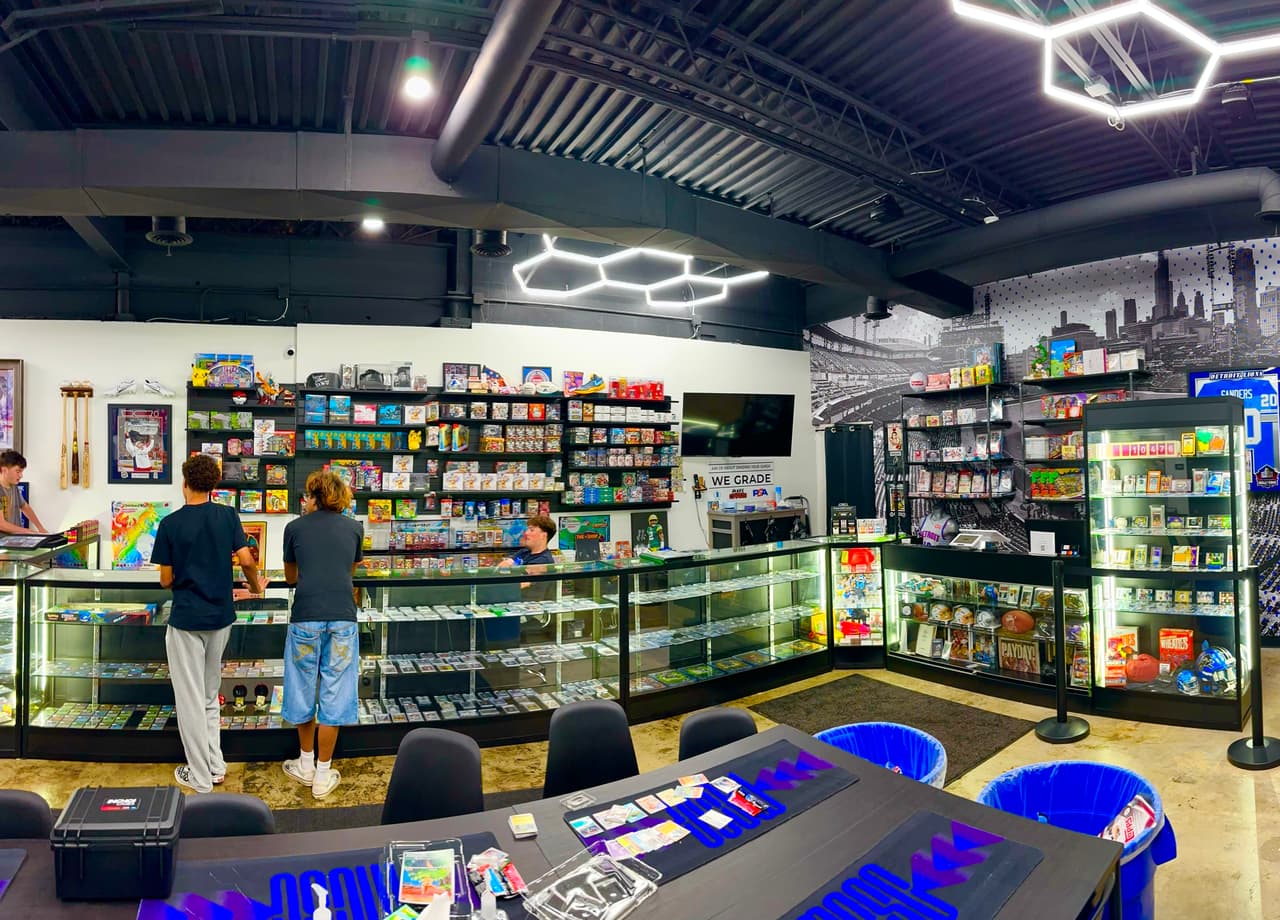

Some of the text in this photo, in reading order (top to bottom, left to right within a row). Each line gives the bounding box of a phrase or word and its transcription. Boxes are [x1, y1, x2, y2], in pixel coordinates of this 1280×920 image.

[1220, 389, 1252, 399] SANDERS
[1260, 394, 1277, 407] 20
[712, 474, 772, 486] WE GRADE
[752, 488, 768, 497] PSA
[1001, 642, 1037, 661] PAYDAY!
